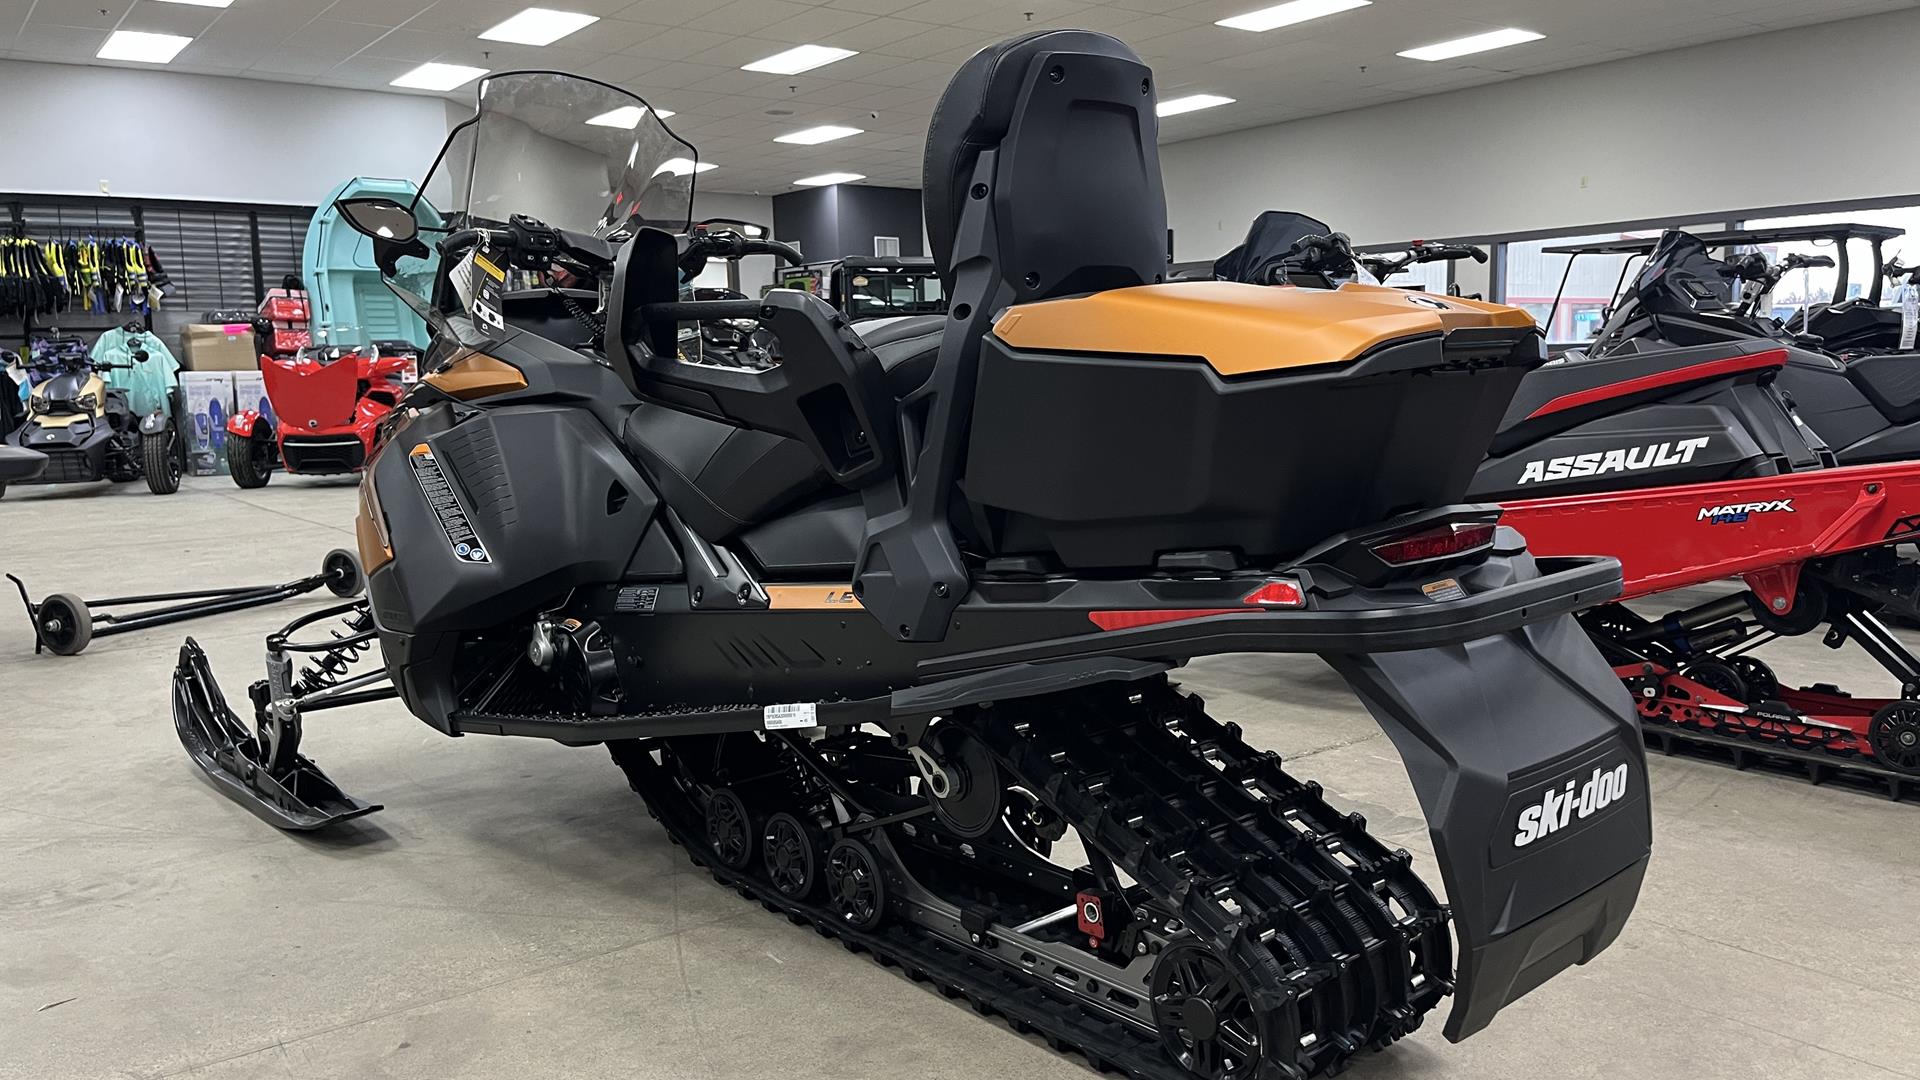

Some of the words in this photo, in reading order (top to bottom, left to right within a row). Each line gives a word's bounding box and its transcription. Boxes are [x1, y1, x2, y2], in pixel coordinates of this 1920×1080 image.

[1517, 436, 1709, 485] ASSAULT
[1697, 499, 1795, 521] MATRYX
[1711, 513, 1748, 524] 146
[1756, 711, 1791, 721] POLARIS
[1513, 763, 1629, 848] ski-doo
